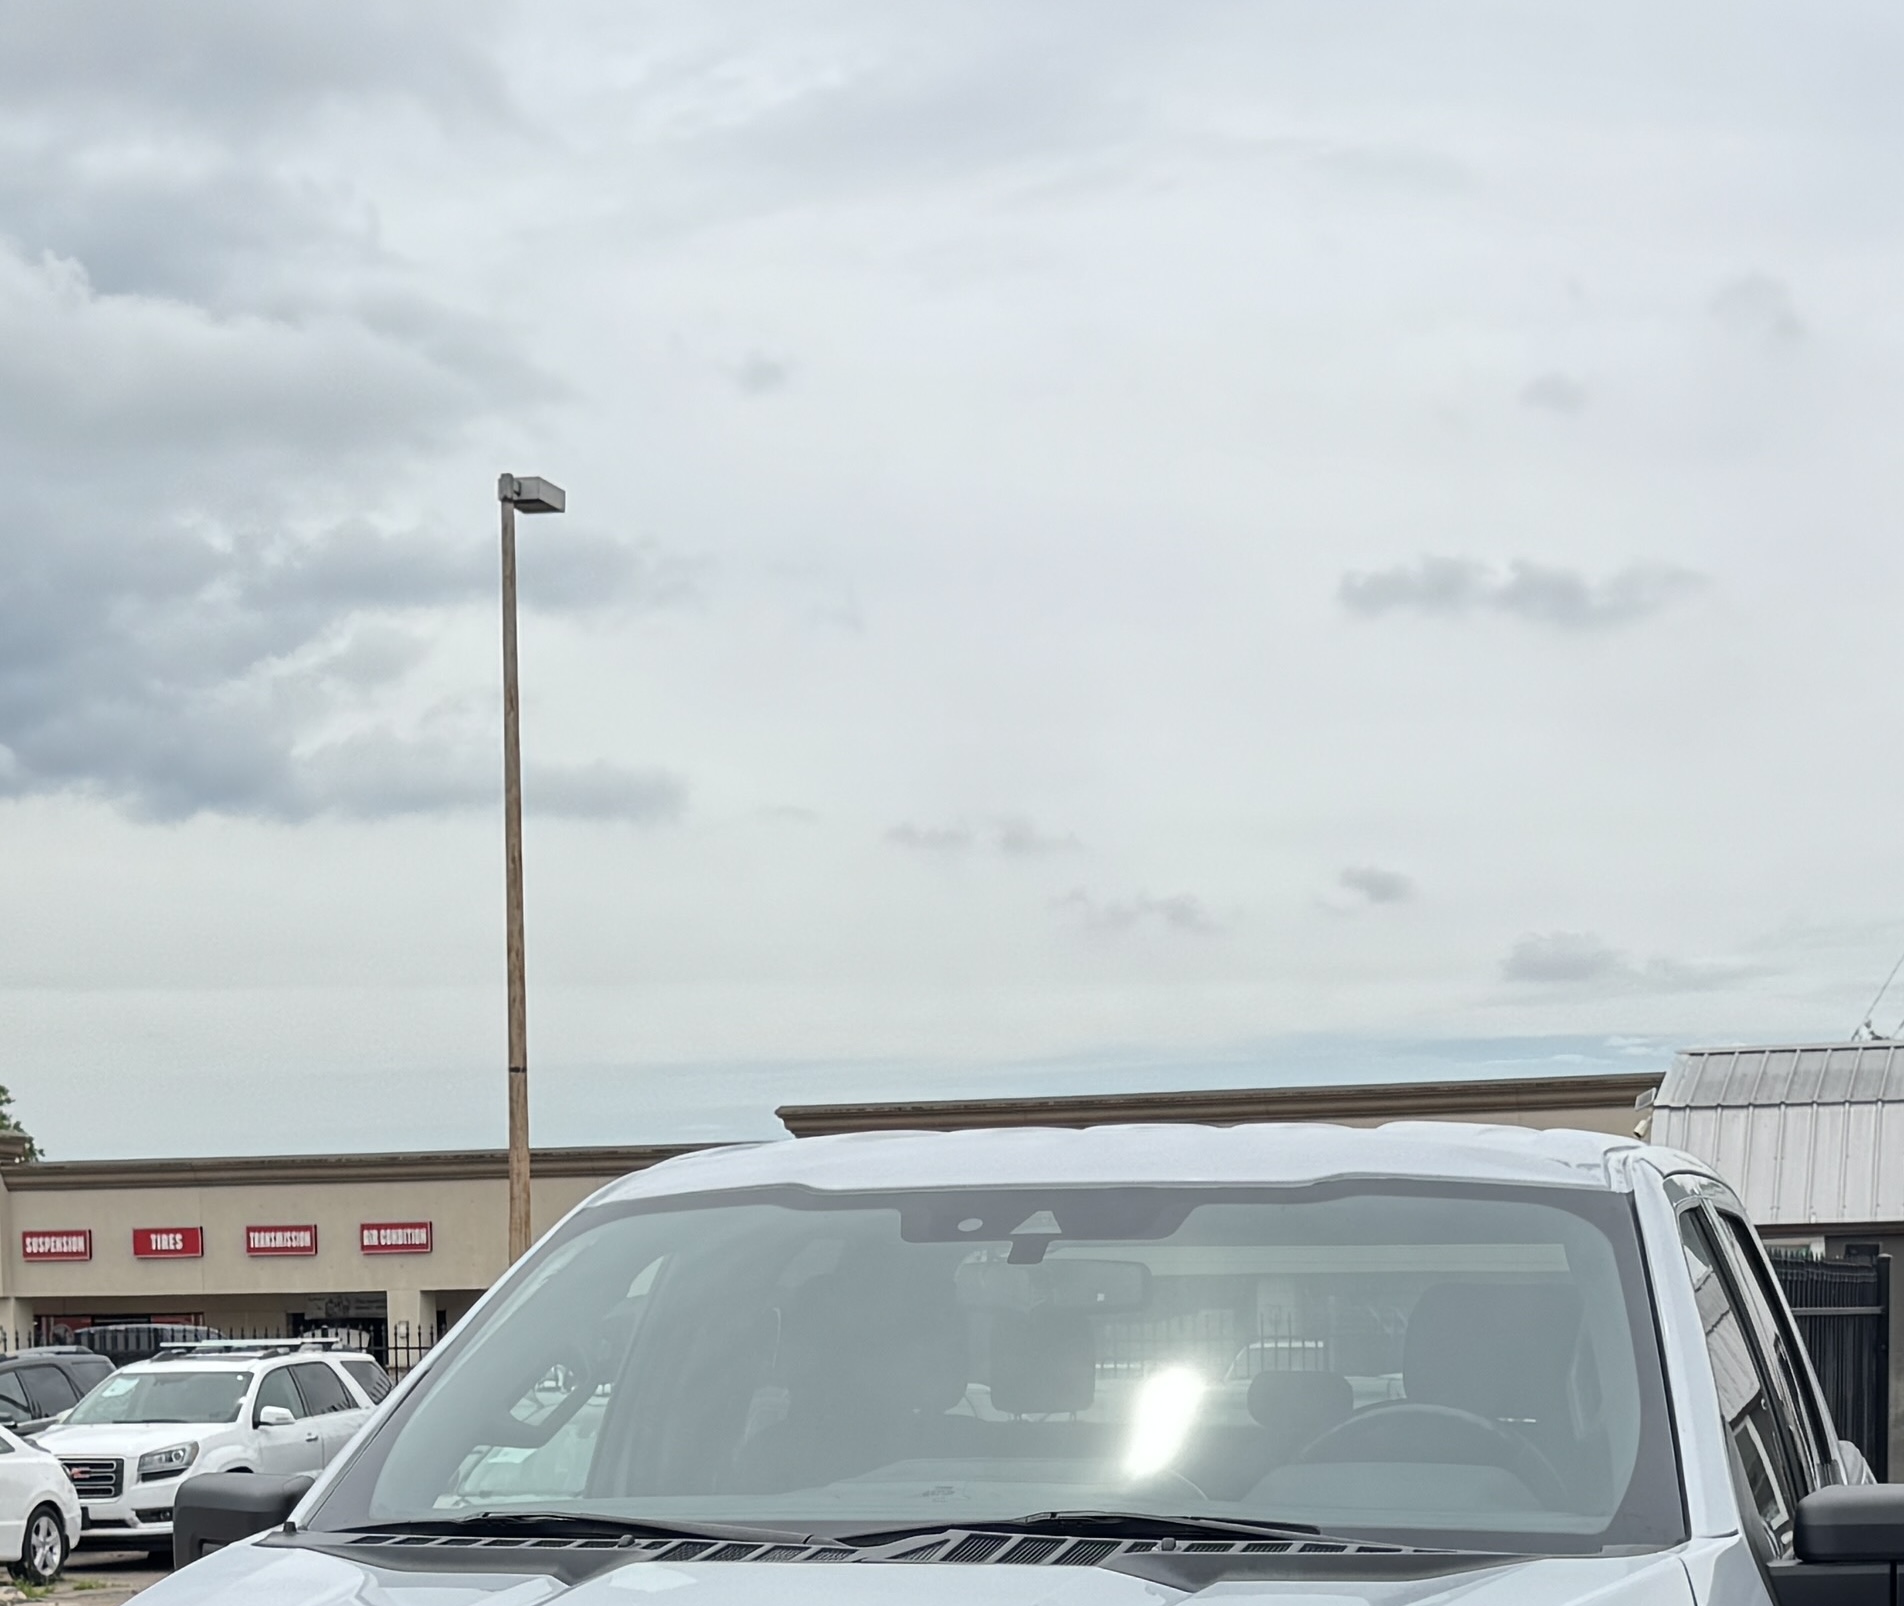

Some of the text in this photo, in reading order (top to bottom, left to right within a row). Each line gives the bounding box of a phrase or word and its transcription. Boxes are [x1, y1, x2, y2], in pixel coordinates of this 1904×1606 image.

[25, 1236, 85, 1254] SUSPENSION
[150, 1233, 183, 1251] TIRES
[249, 1230, 311, 1248] TRANSMISSION
[380, 1228, 427, 1245] CONDITION
